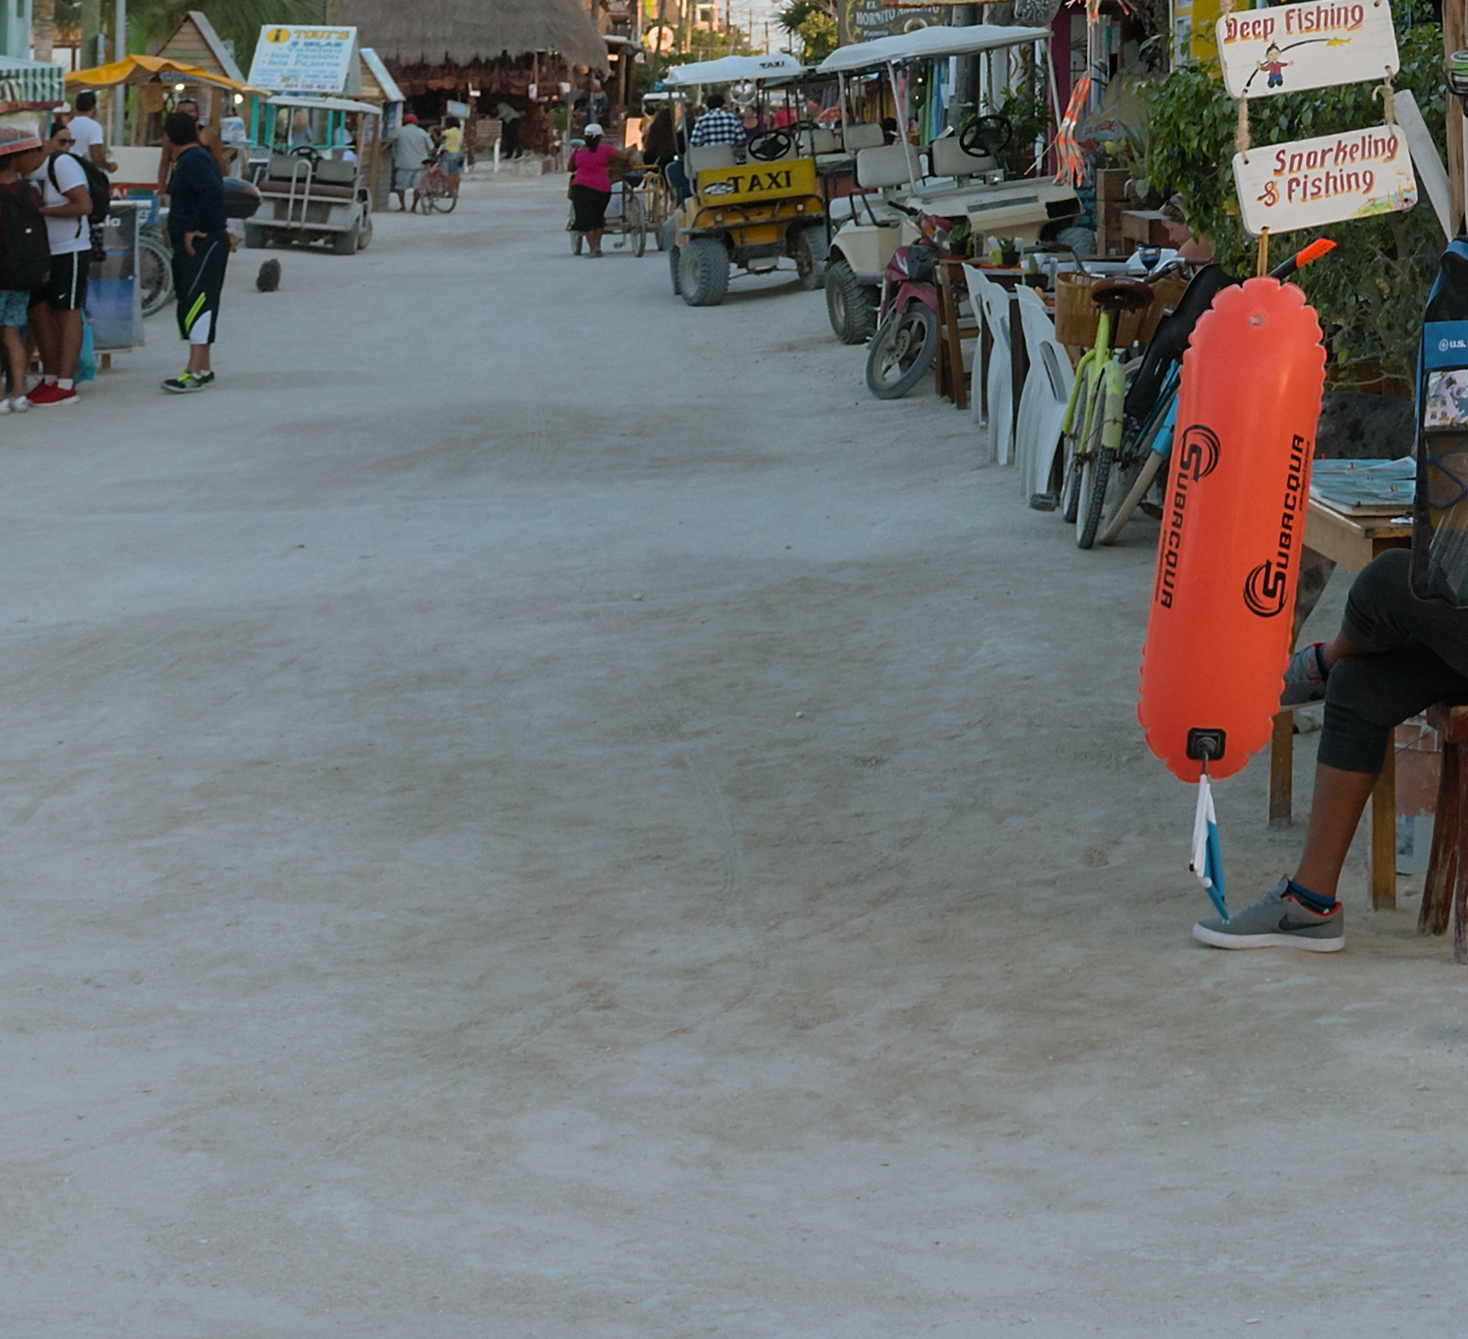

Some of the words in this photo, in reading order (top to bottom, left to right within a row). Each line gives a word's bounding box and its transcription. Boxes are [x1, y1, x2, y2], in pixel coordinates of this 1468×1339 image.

[1224, 17, 1275, 44] Deep
[759, 60, 785, 69] TAXI
[1273, 134, 1399, 177] Snorkeling
[726, 170, 793, 194] TAXI
[1161, 442, 1204, 609] SUBACQUA
[1261, 433, 1305, 599] SUBACQUA
